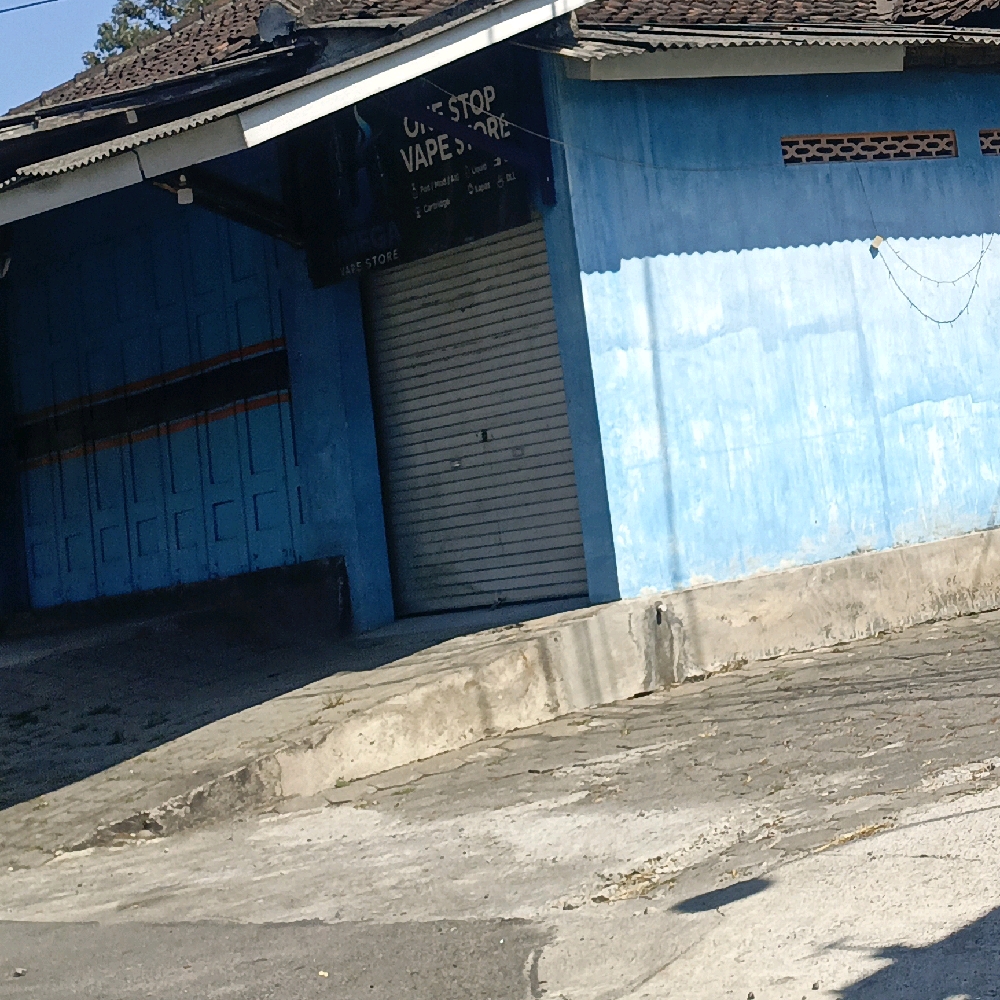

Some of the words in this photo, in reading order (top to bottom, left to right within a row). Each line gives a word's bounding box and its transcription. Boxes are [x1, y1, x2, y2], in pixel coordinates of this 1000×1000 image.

[448, 86, 496, 122] STOP
[400, 133, 453, 173] VAPE
[365, 248, 399, 269] STORE
